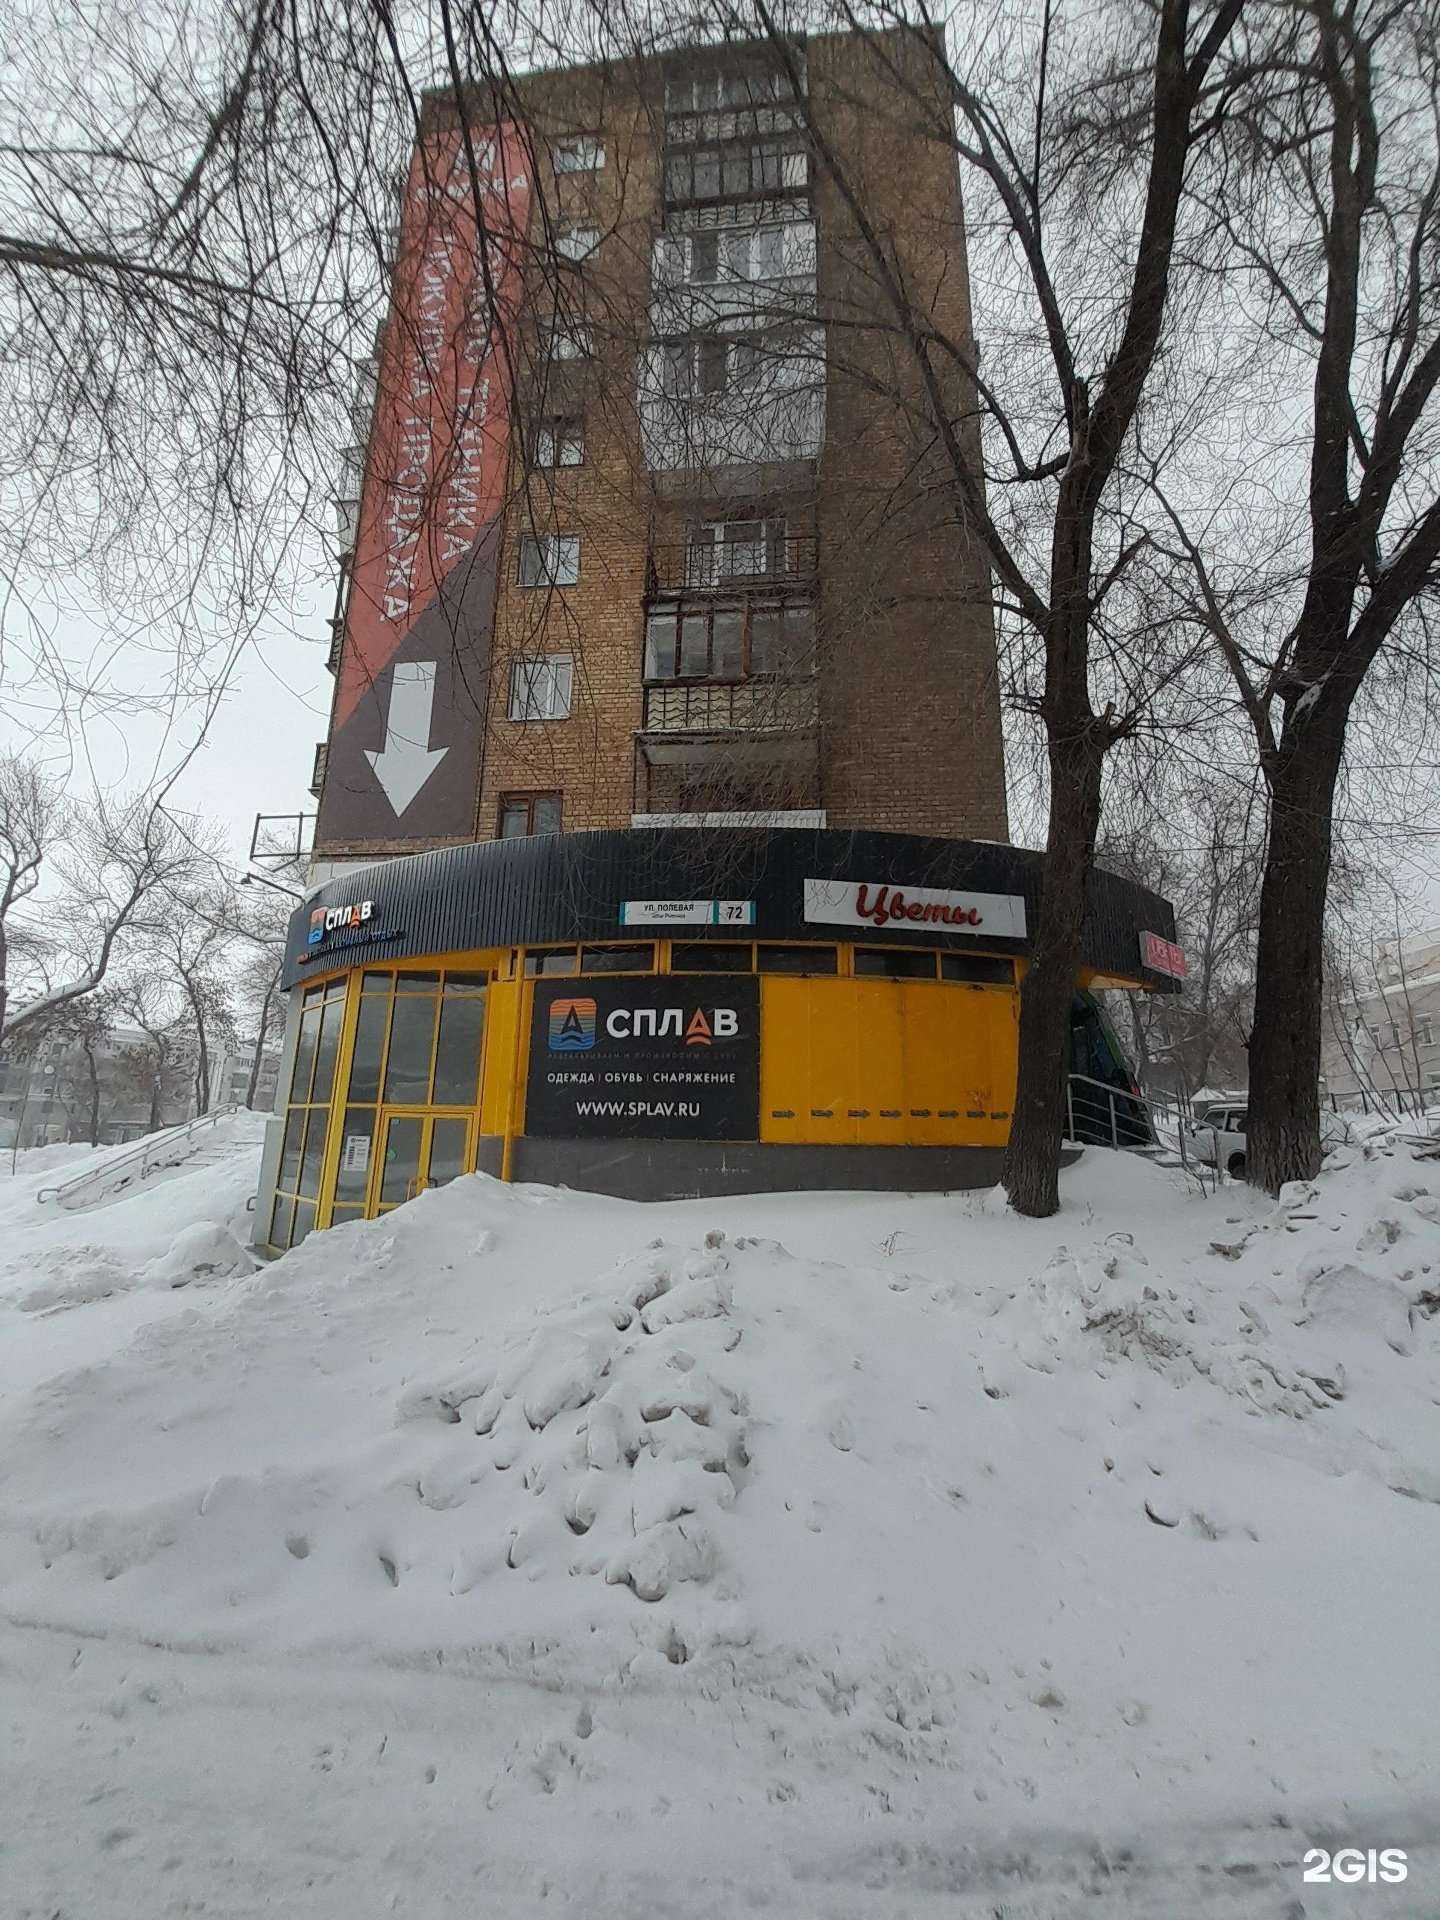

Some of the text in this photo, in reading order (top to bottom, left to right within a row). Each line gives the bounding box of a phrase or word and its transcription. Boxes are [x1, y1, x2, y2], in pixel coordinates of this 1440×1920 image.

[442, 378, 490, 560] ТЕХНИКА
[380, 415, 434, 622] ПРОДАЖА
[325, 900, 373, 931] СПЛАВ
[657, 903, 694, 912] ПОЛЕВАЯ
[727, 906, 744, 920] 72
[856, 884, 983, 925] Цветы
[606, 1007, 739, 1046] СПЛАВ
[547, 1072, 736, 1084] ОДЕЖДА ОБУВЬ СНАРЯЖЕНИЕ
[576, 1101, 700, 1117] WWW.SPLAV.RU
